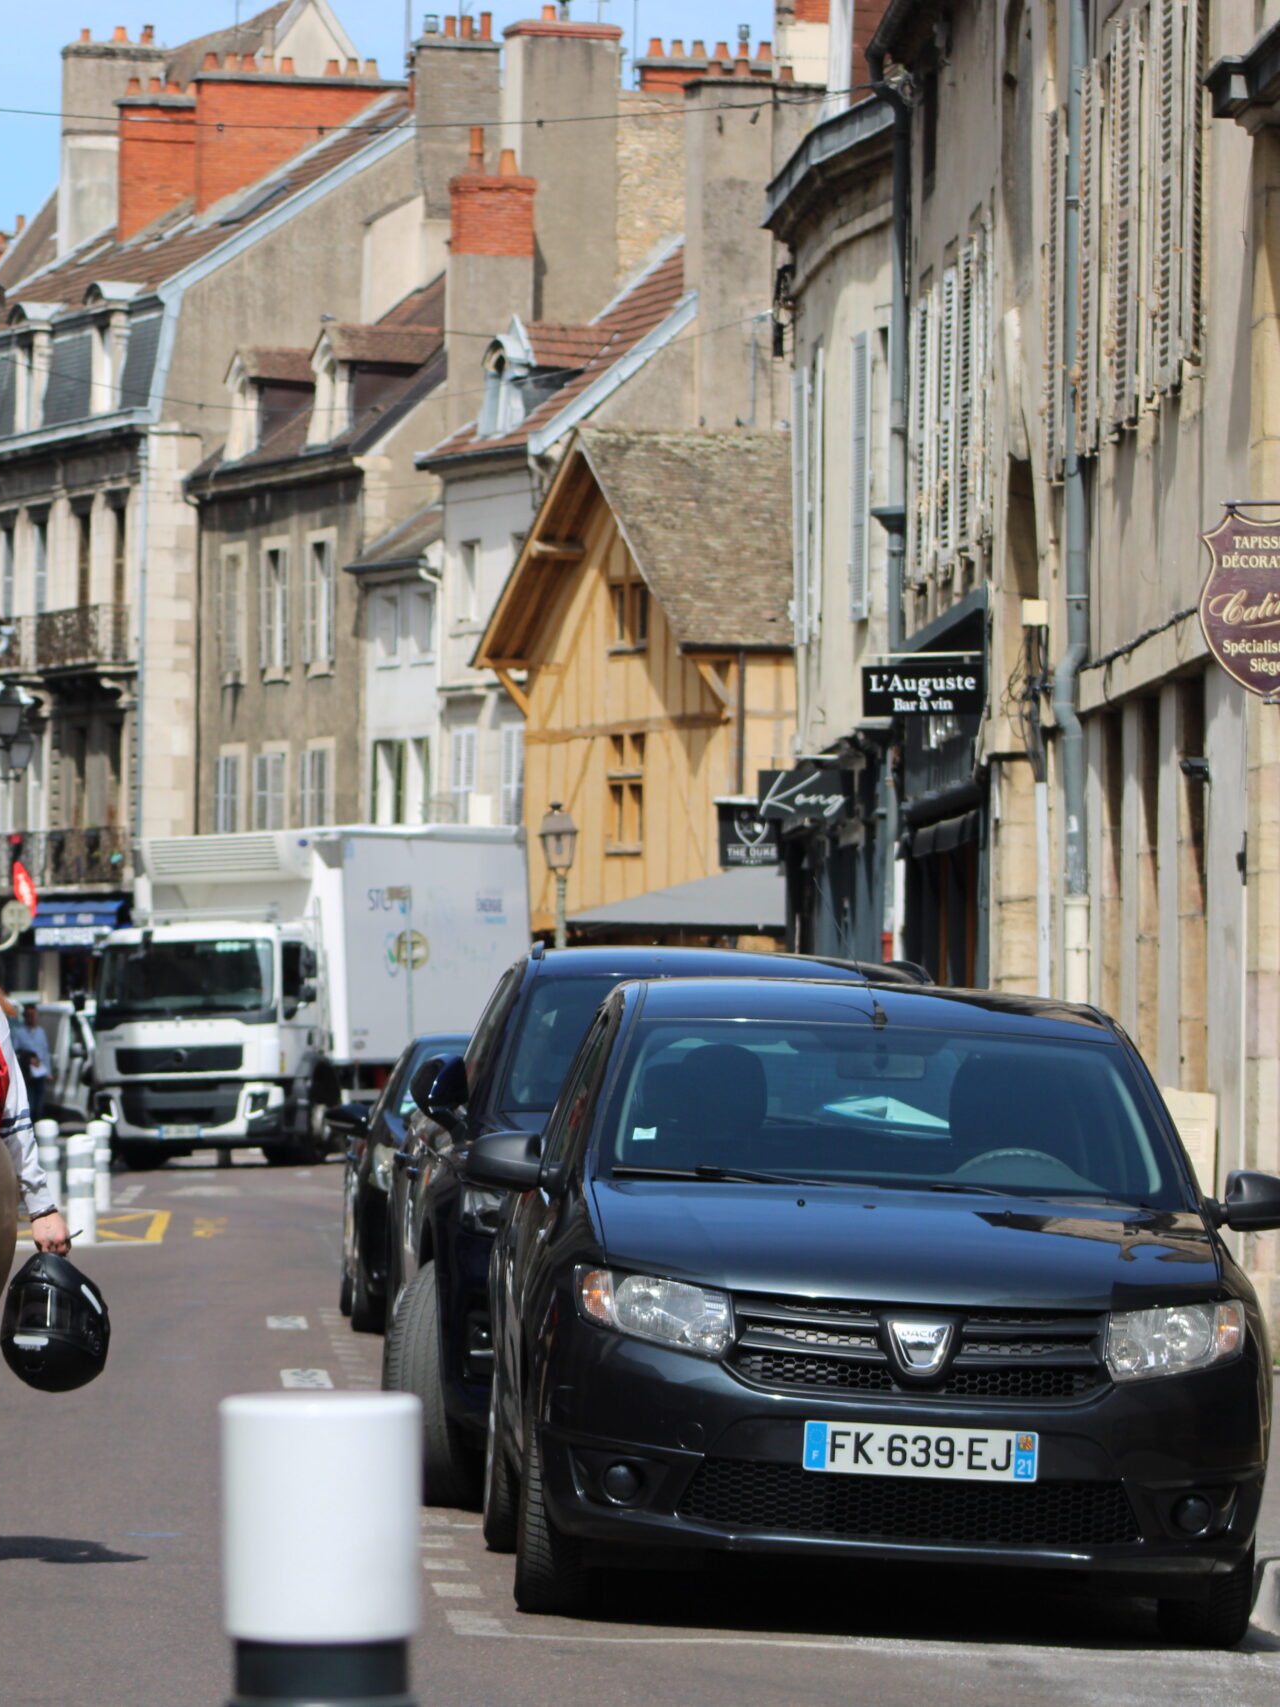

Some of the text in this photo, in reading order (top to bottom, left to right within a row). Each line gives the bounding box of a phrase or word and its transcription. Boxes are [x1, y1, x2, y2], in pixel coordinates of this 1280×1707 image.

[893, 696, 953, 712] Bar à vin
[759, 770, 847, 817] Kong
[727, 846, 778, 857] THE DUKE
[811, 1430, 1032, 1475] F FK-639-EJ 21
